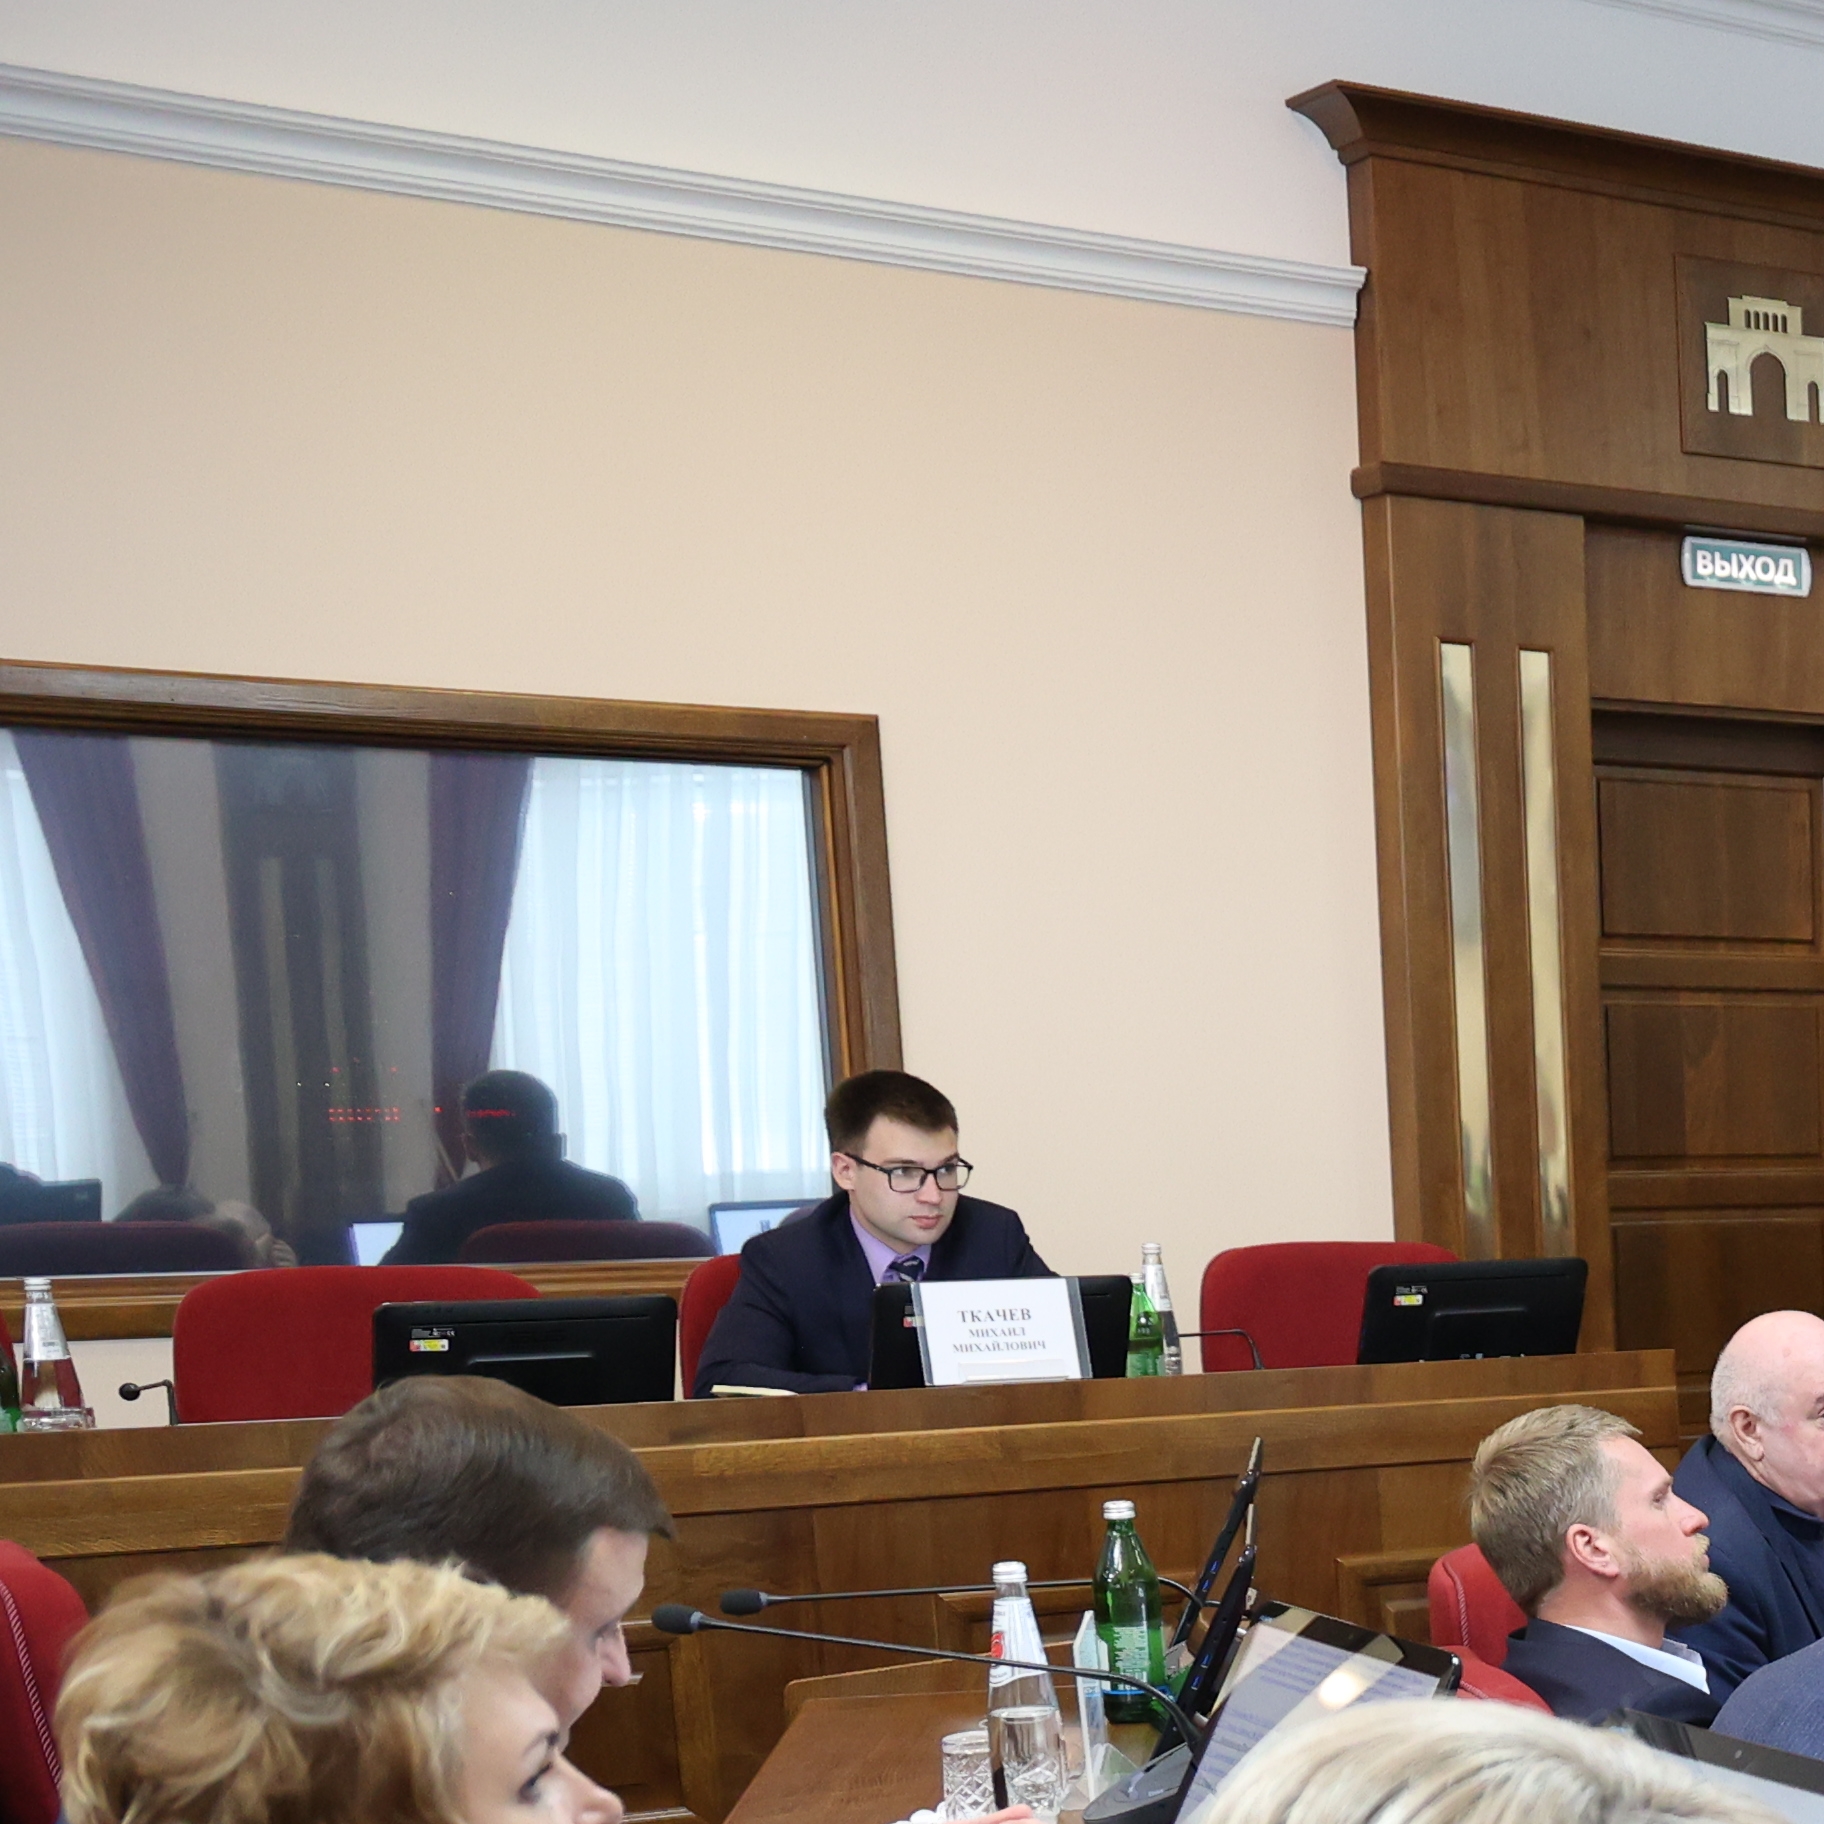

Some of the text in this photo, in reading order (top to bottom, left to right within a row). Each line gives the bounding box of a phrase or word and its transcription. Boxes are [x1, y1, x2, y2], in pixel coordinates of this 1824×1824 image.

[1696, 549, 1797, 587] ВЫХОД
[957, 1308, 1032, 1324] ТКАЧЕВ
[968, 1327, 1026, 1339] МИХАИЛ
[953, 1340, 1047, 1354] МИХАЙЛОВИЧ
